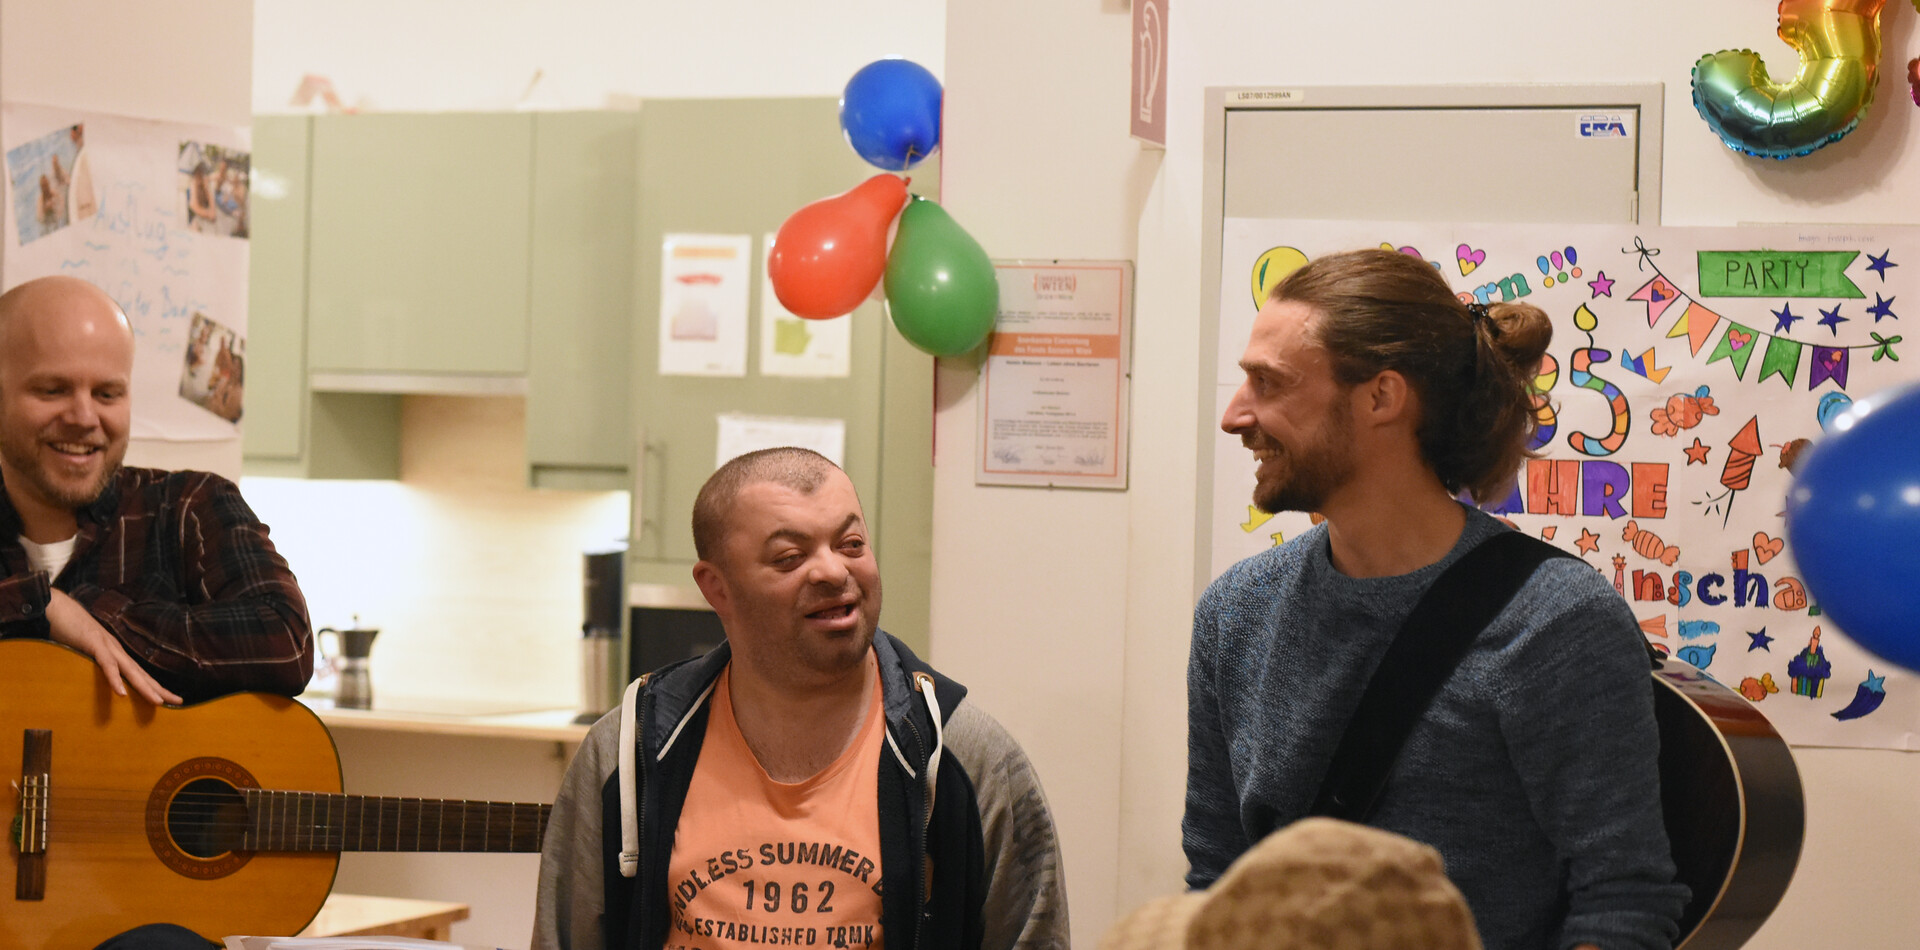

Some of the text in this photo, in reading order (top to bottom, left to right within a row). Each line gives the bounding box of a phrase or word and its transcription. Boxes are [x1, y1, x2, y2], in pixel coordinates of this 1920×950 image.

[1041, 282, 1072, 292] WIEN
[1725, 259, 1809, 290] PARTY
[1612, 548, 1821, 617] inscha
[759, 842, 875, 884] SUMMER
[743, 880, 835, 914] 1962
[694, 917, 817, 946] ESTABLISHED
